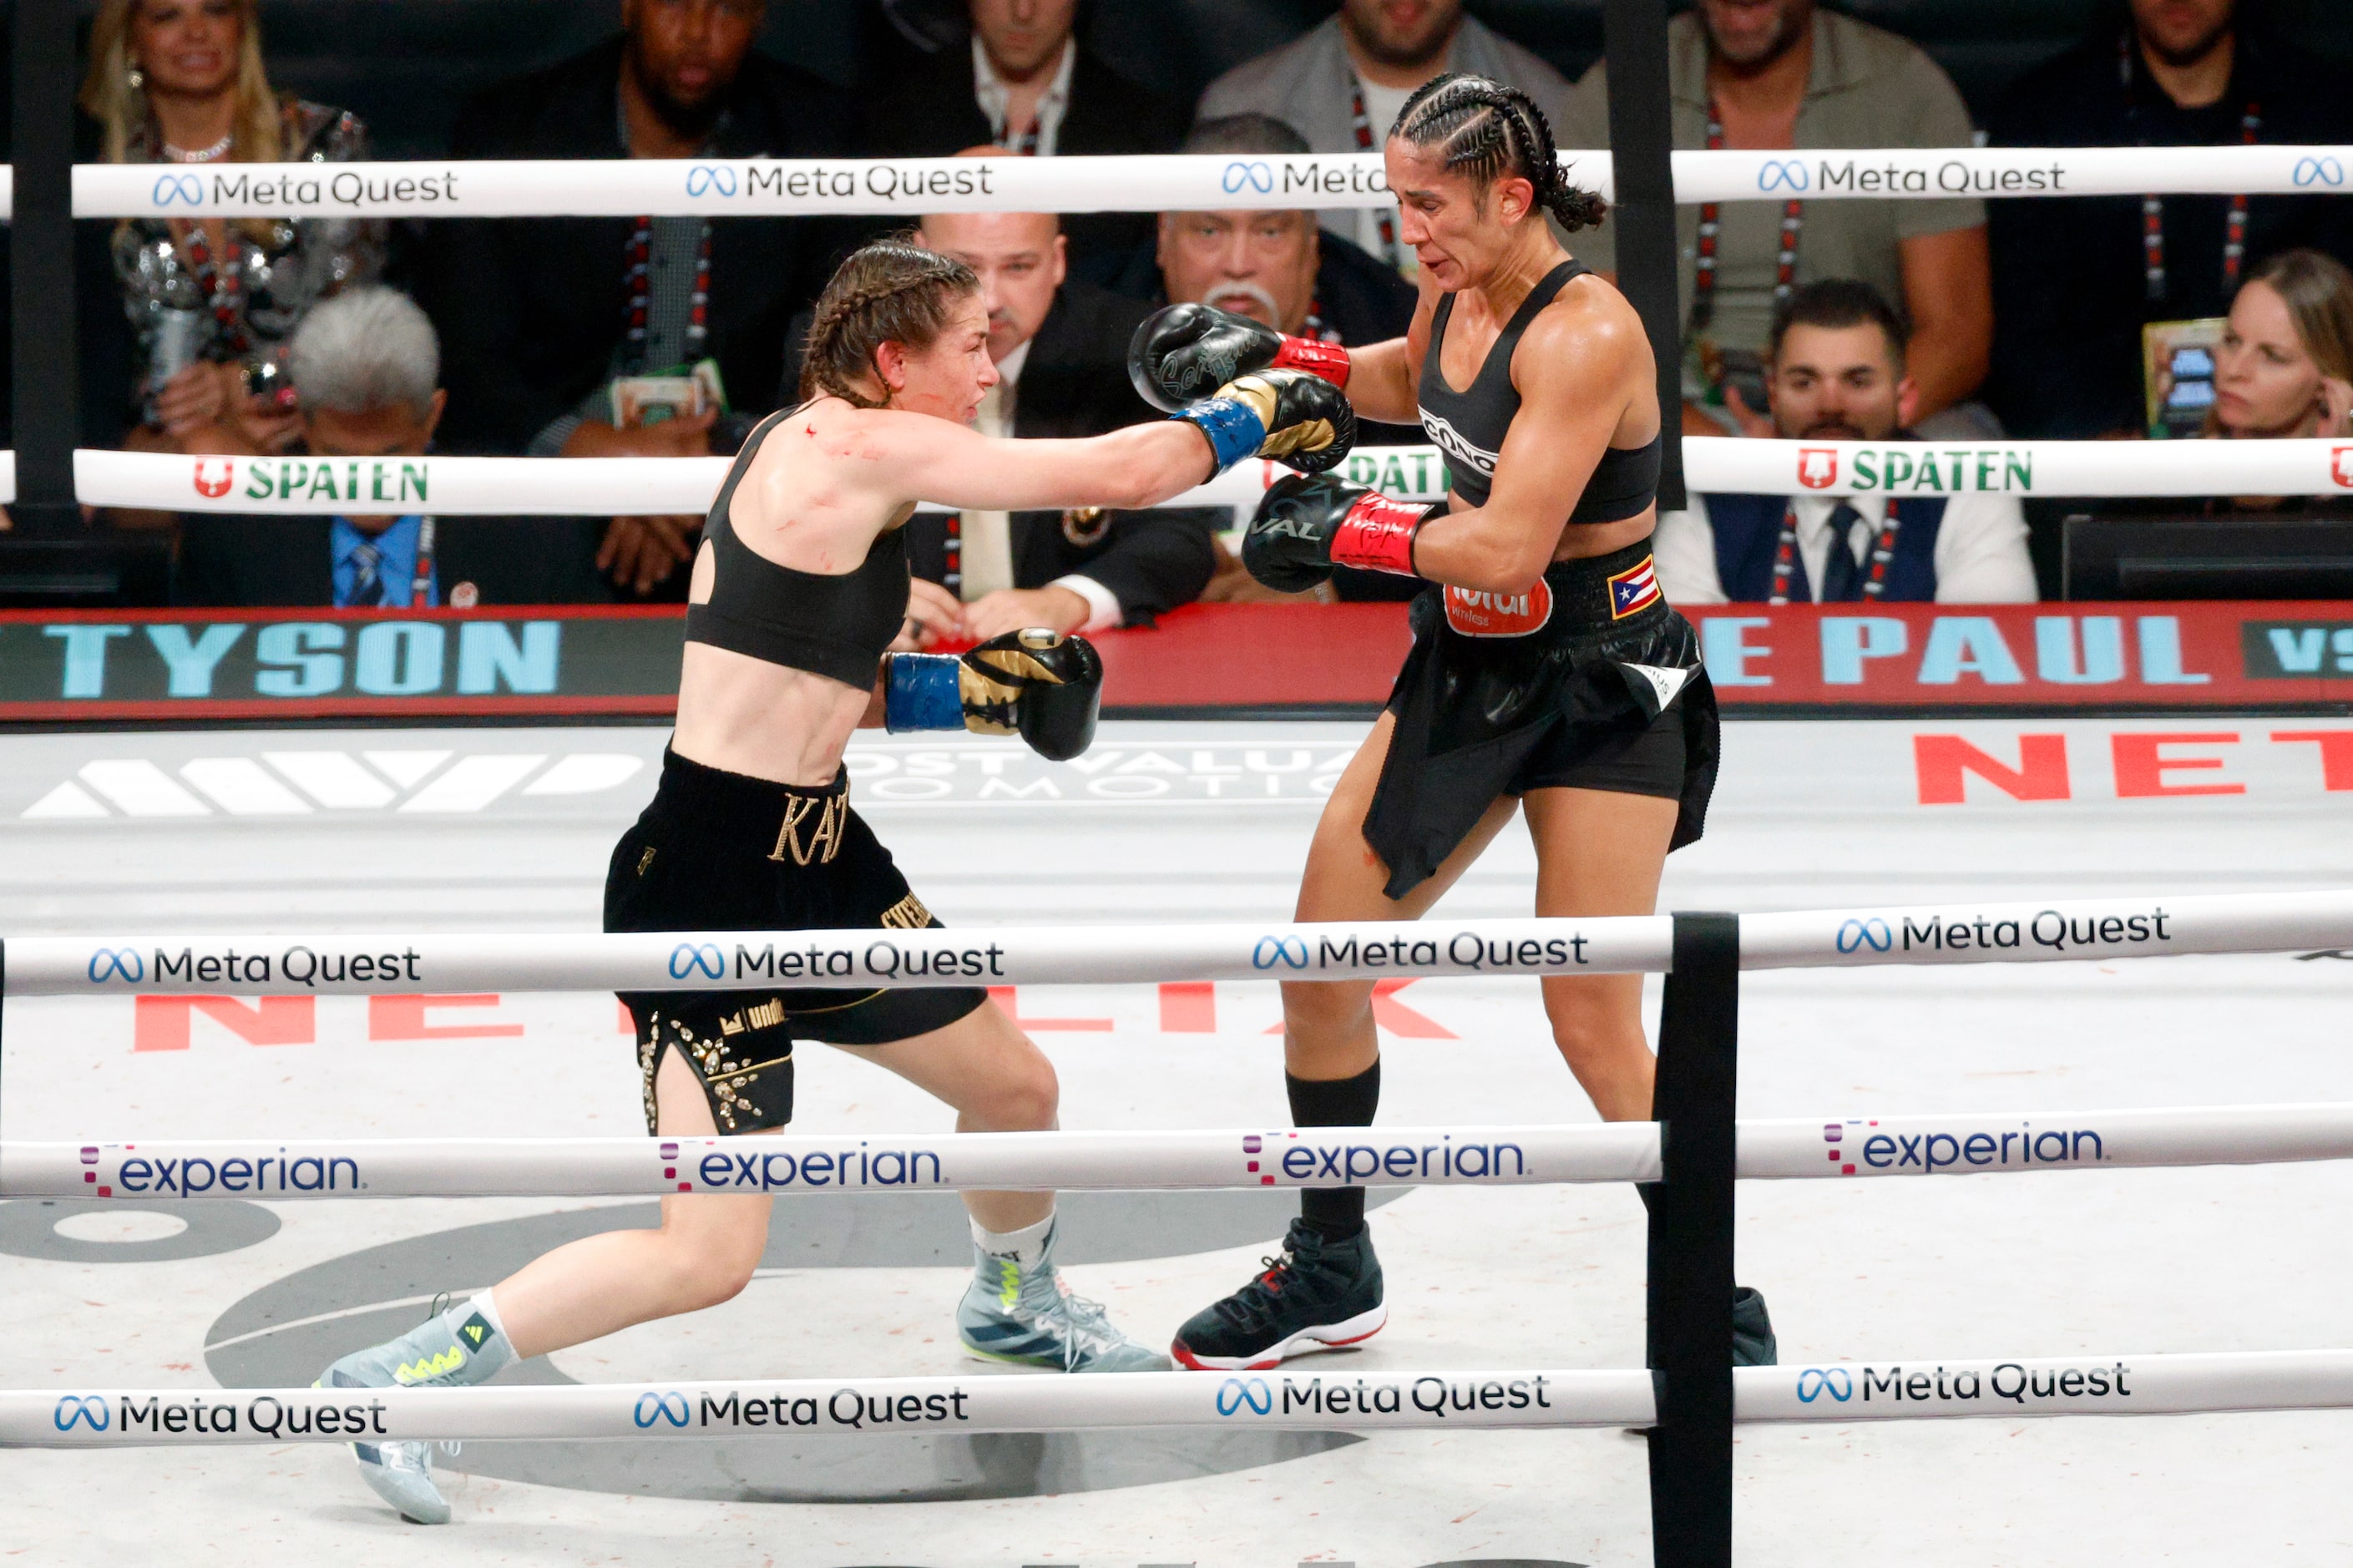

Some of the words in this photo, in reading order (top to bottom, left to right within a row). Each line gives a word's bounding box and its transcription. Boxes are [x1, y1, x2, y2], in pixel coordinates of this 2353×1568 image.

[213, 174, 320, 205] Meta
[331, 170, 459, 205] Quest
[747, 166, 854, 198] Meta
[866, 163, 994, 200] Quest
[1819, 161, 1926, 192] Meta
[1938, 160, 2066, 195] Quest
[245, 459, 428, 501] SPATEN
[1851, 451, 2032, 492] SPATEN
[42, 620, 561, 698] TYSON
[1819, 615, 2210, 685] PAUL
[842, 751, 1029, 776] OST
[1902, 916, 2020, 951] Meta
[2032, 907, 2171, 951] Quest
[154, 948, 271, 984] Meta
[281, 945, 421, 986] Quest
[735, 943, 853, 979] Meta
[863, 941, 1004, 980] Quest
[1318, 933, 1437, 969] Meta
[1449, 931, 1588, 970] Quest
[1283, 1378, 1400, 1414] Meta
[1411, 1375, 1551, 1417] Quest
[1863, 1367, 1981, 1402] Meta
[1991, 1362, 2132, 1404] Quest
[120, 1396, 237, 1432] Meta
[247, 1396, 387, 1438] Quest
[700, 1390, 818, 1426] Meta
[828, 1387, 969, 1429] Quest
